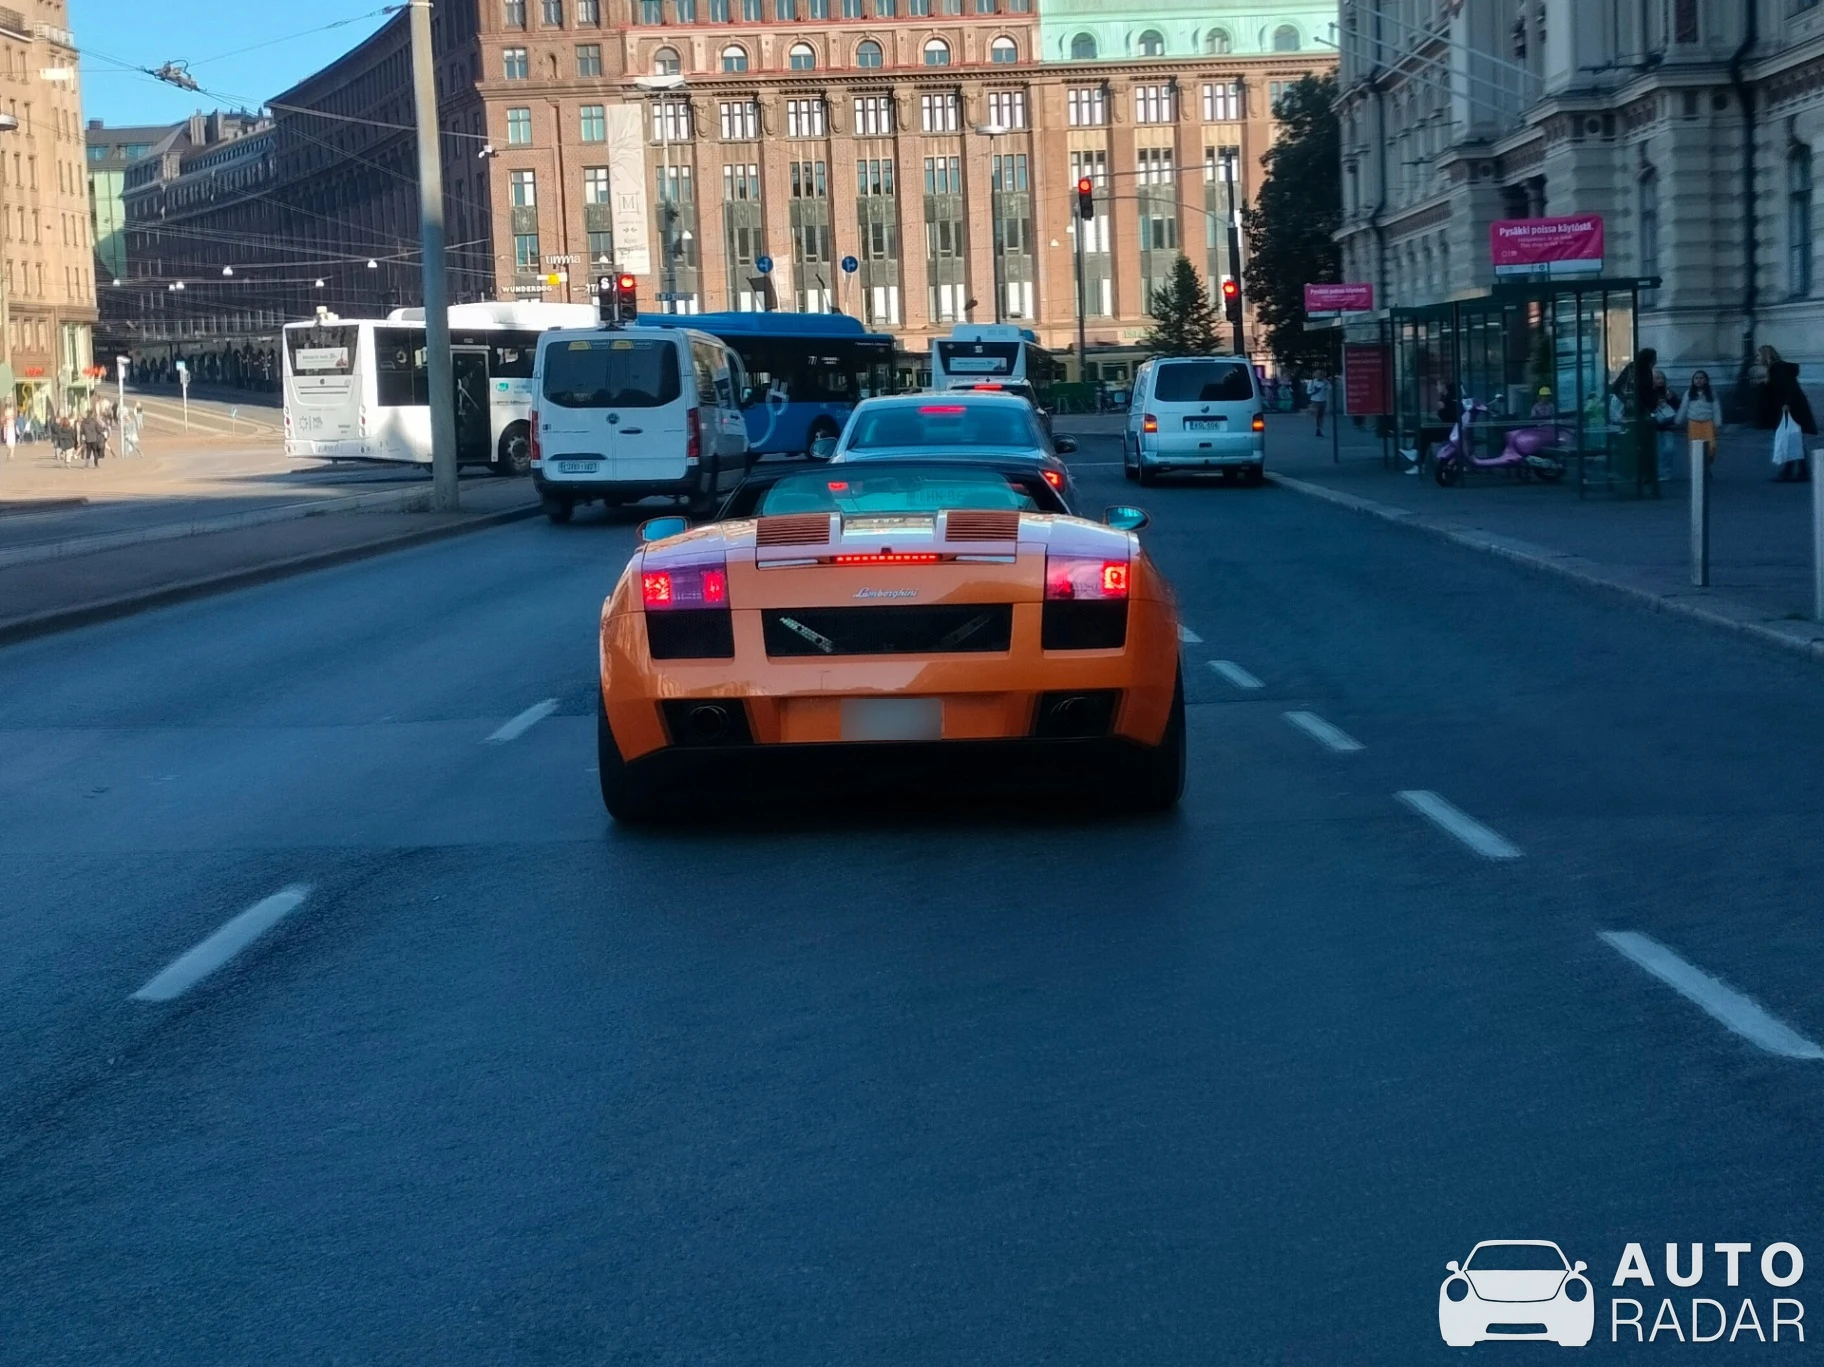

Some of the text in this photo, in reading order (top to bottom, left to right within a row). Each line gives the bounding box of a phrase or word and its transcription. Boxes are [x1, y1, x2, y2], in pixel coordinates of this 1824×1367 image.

[1500, 226, 1530, 237] Pysäkki
[1532, 225, 1556, 236] poissa
[852, 586, 918, 598] Lamborghini
